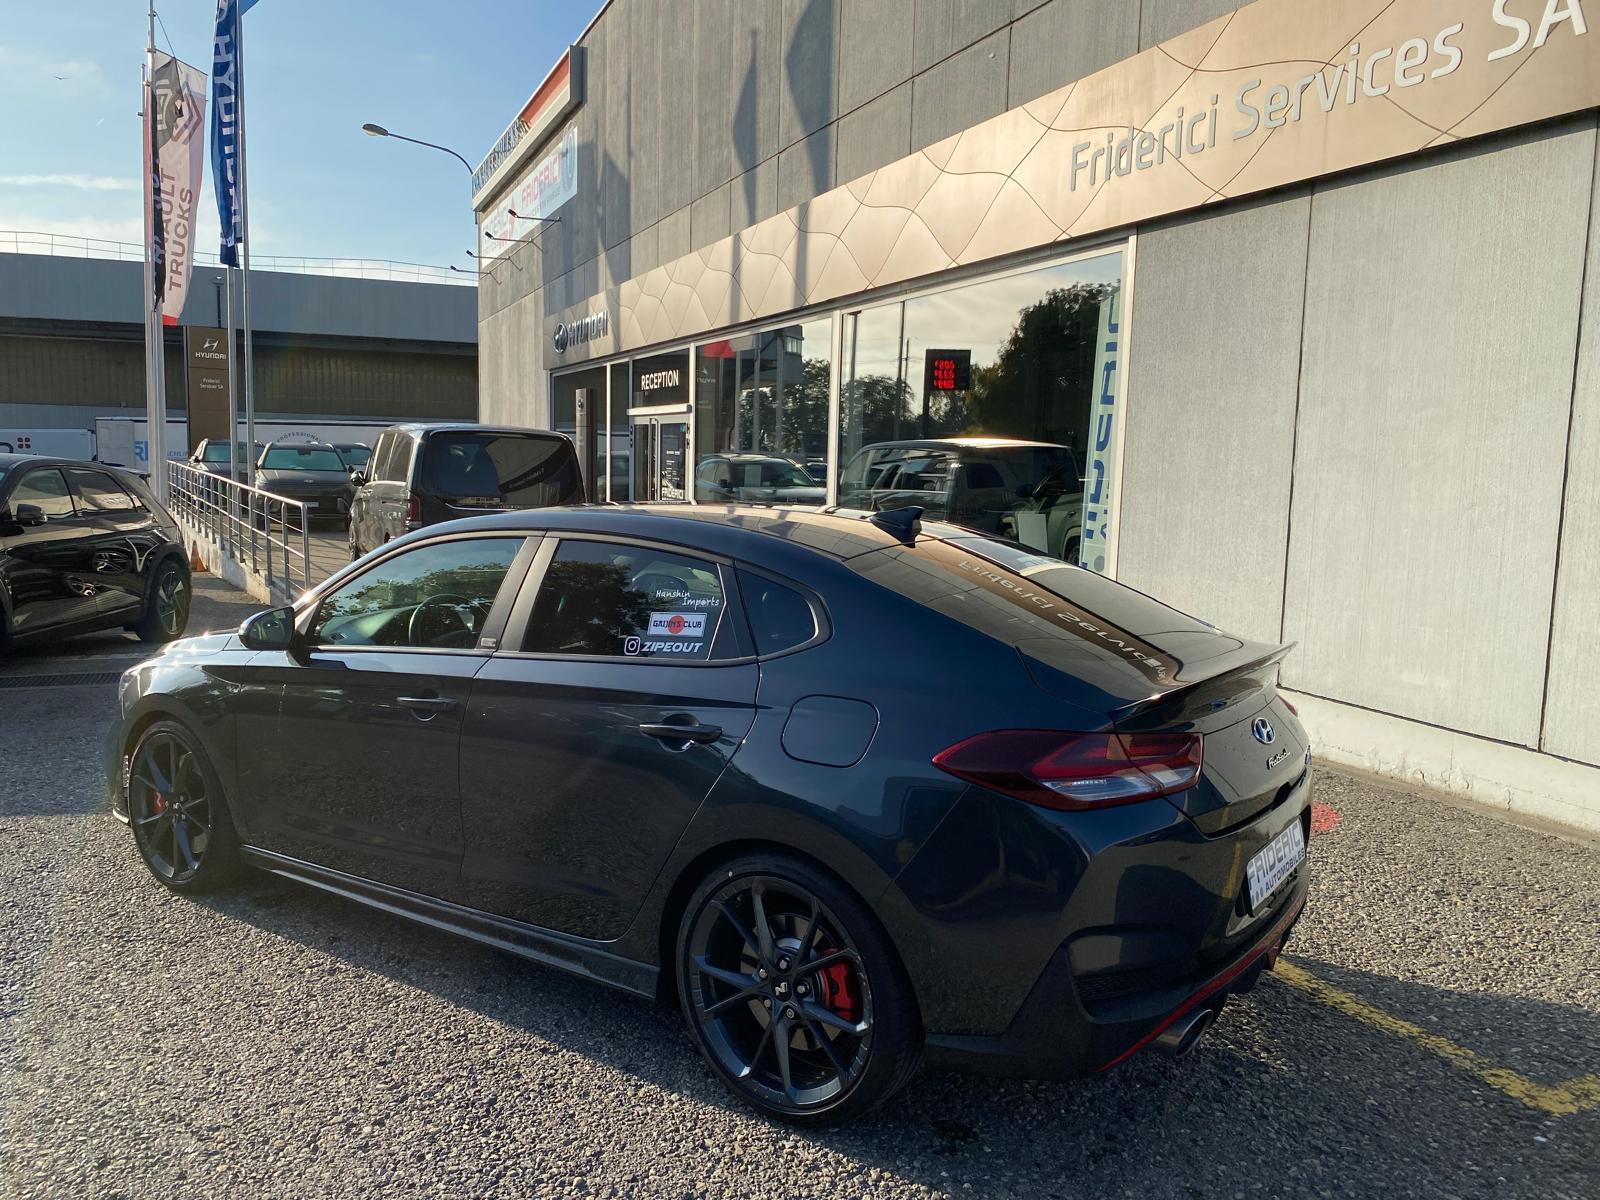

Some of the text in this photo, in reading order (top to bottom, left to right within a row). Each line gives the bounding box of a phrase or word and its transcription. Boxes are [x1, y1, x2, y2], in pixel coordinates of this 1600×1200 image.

[1071, 0, 1588, 192] Friderici Services SA
[168, 187, 193, 292] TRUCKS
[567, 310, 608, 347] HYUNDAI
[195, 351, 227, 360] HYUNDAI
[641, 369, 679, 390] RECEPTION
[655, 589, 691, 598] Hanshin
[681, 596, 719, 610] Imports
[683, 620, 703, 629] CLUB
[641, 641, 703, 653] ZIPEOUT
[1265, 848, 1305, 893] AUTOMOBILES
